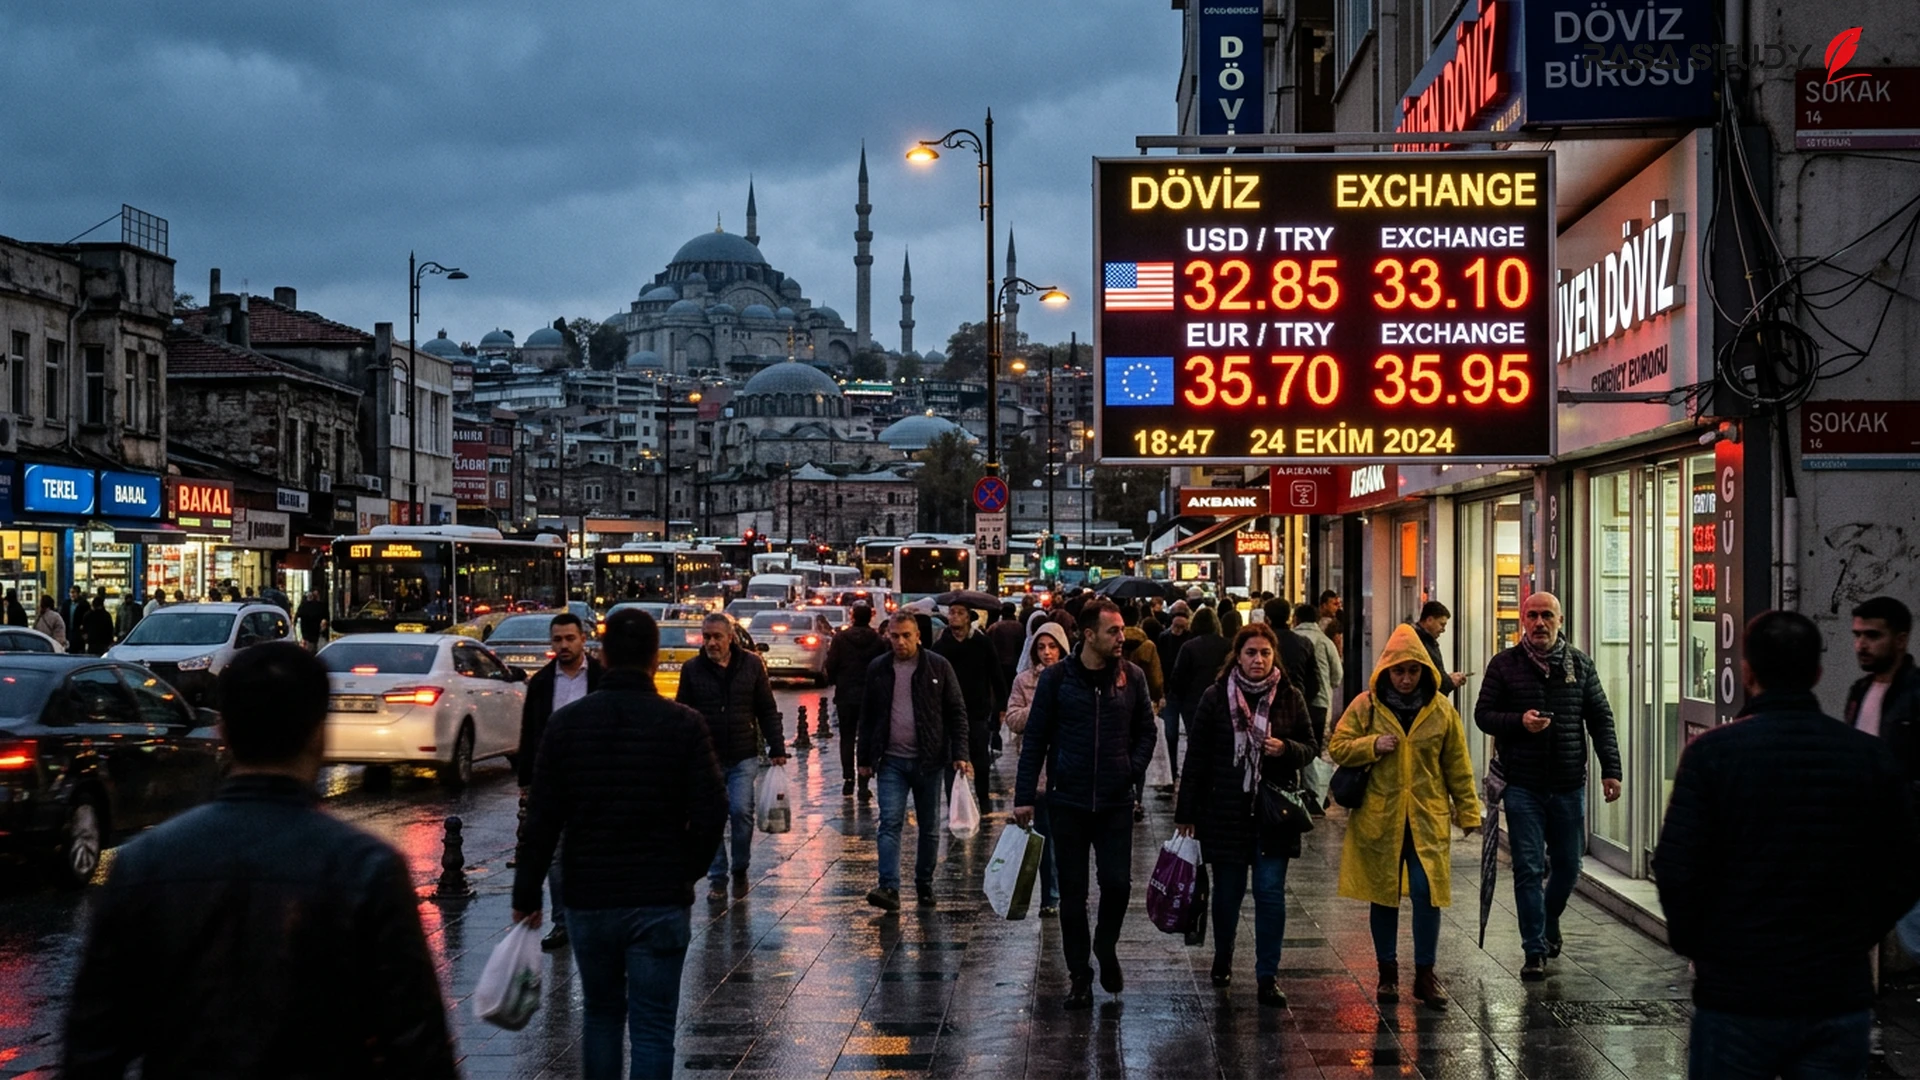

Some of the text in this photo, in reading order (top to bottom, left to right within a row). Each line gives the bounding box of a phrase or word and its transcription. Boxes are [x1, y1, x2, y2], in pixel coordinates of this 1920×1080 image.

[1553, 1, 1685, 45] DÖVİZ
[1218, 35, 1245, 155] DÖV
[1805, 79, 1892, 103] SOKAK
[1805, 110, 1823, 124] 14
[1130, 167, 1537, 210] DÖVİZ EXCHANGE
[1186, 226, 1525, 252] USD / TRY EXCHANGE
[1183, 257, 1530, 311] 32.85 33.10
[1605, 199, 1675, 340] DÖVİZ
[1186, 321, 1526, 347] EUR / TRY EXCHANGE
[1183, 354, 1340, 407] 35.70
[1373, 353, 1531, 405] 35.95
[1809, 411, 1889, 434] SOKAK
[1133, 421, 1456, 455] 18:47 24 EKİM 2024
[1809, 438, 1823, 449] 16
[42, 478, 78, 500] TEKEL
[179, 485, 232, 515] BAKAL
